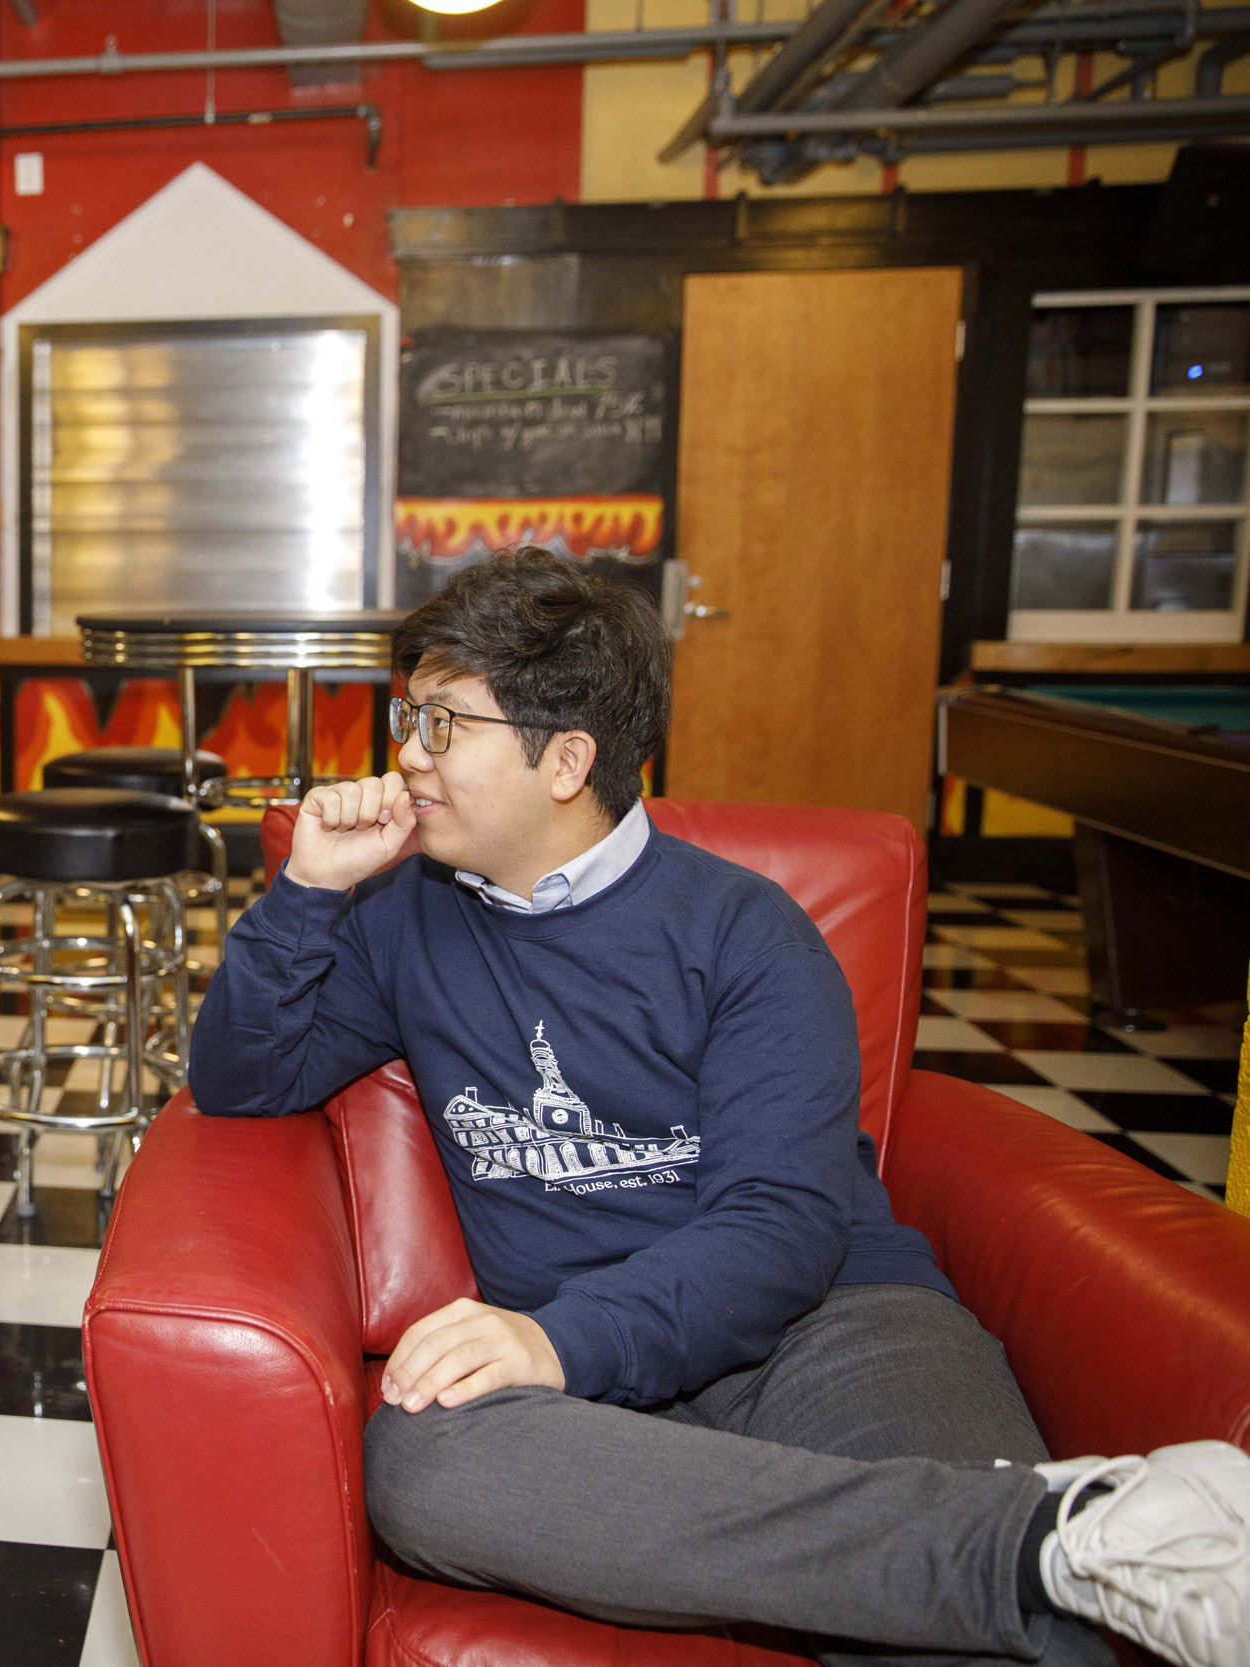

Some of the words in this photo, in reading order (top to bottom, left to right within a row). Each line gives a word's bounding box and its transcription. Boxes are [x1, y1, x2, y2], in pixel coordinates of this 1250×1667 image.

[426, 355, 619, 398] SPECIALS
[619, 1175, 647, 1188] est.
[648, 1170, 680, 1184] 1931
